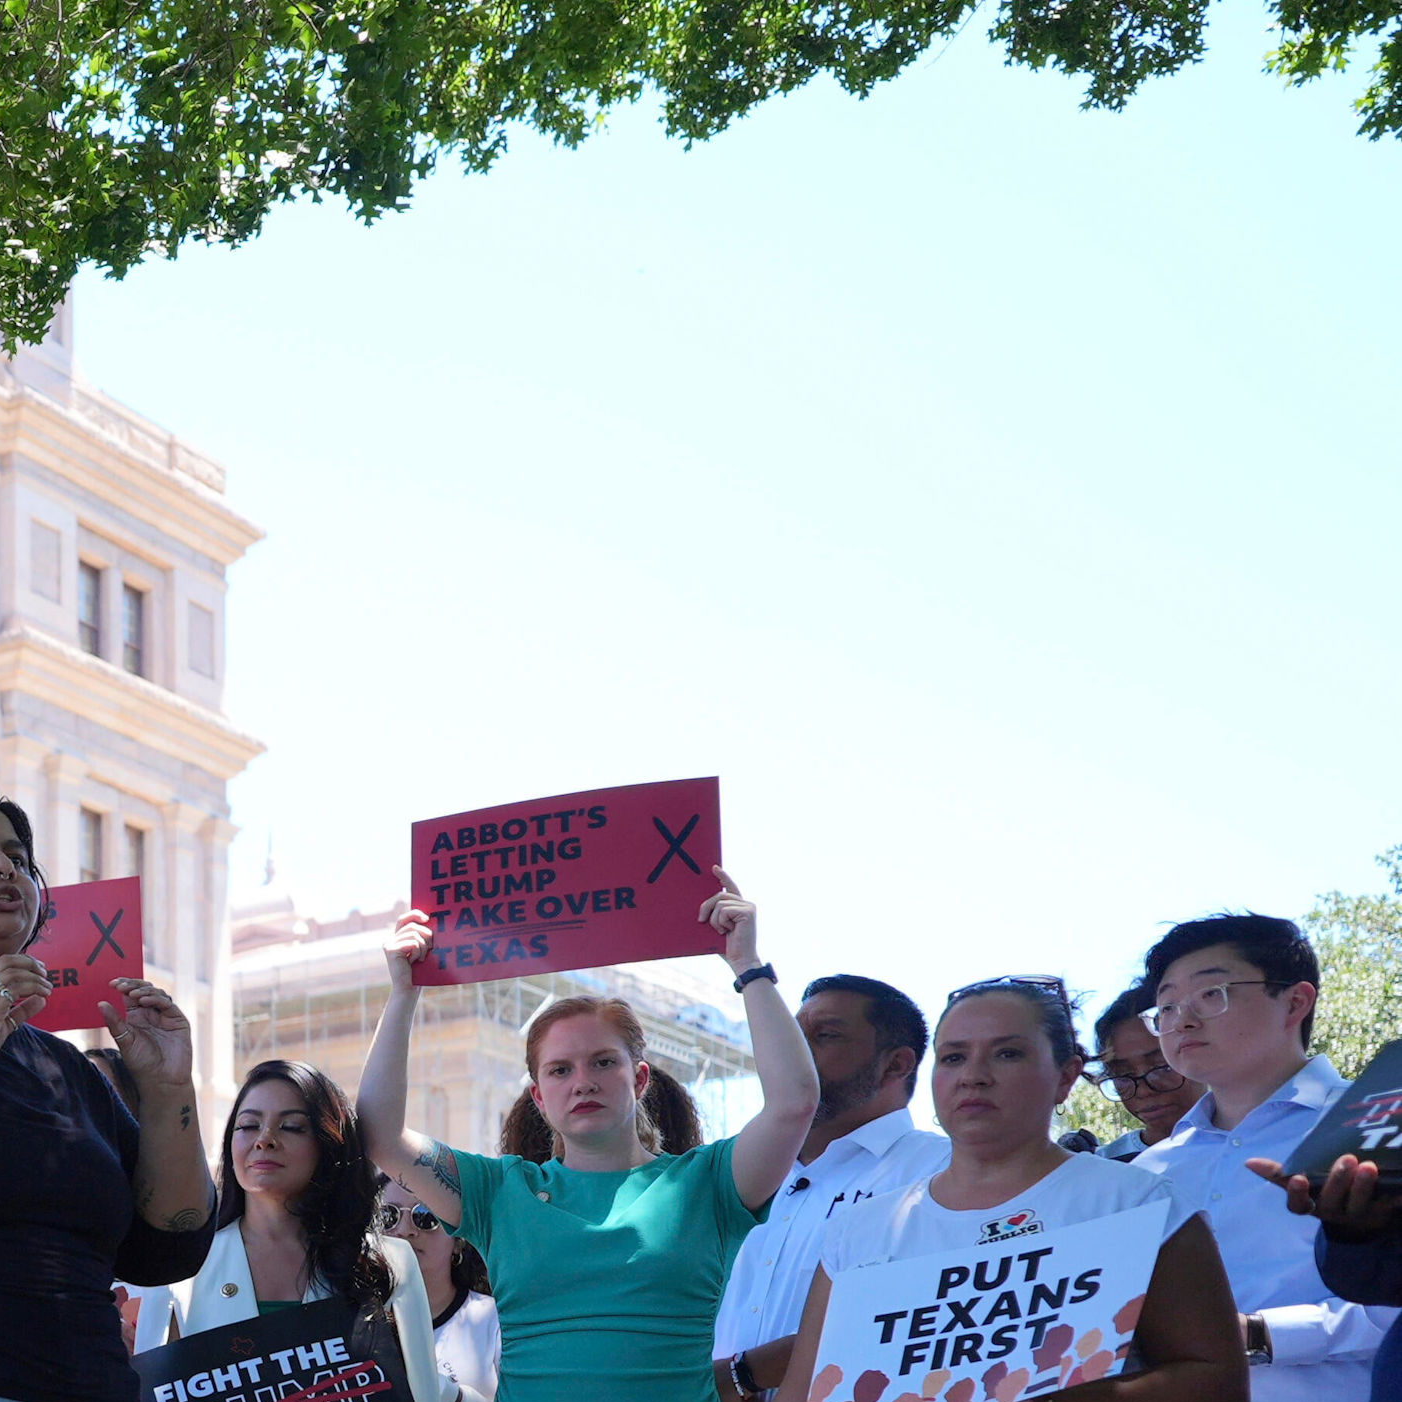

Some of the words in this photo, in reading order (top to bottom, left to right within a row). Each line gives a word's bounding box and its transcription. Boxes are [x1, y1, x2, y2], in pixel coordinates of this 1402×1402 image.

[430, 805, 608, 854] ABBOTT'S
[431, 836, 582, 880] LETTING
[429, 900, 526, 933] TAKE
[535, 886, 637, 919] OVER
[430, 868, 557, 905] TRUMP
[431, 934, 550, 970] TEXAS
[936, 1247, 1054, 1300] PUT
[874, 1268, 1103, 1345] TEXANS
[269, 1336, 350, 1375] THE
[898, 1313, 1060, 1376] FIRST
